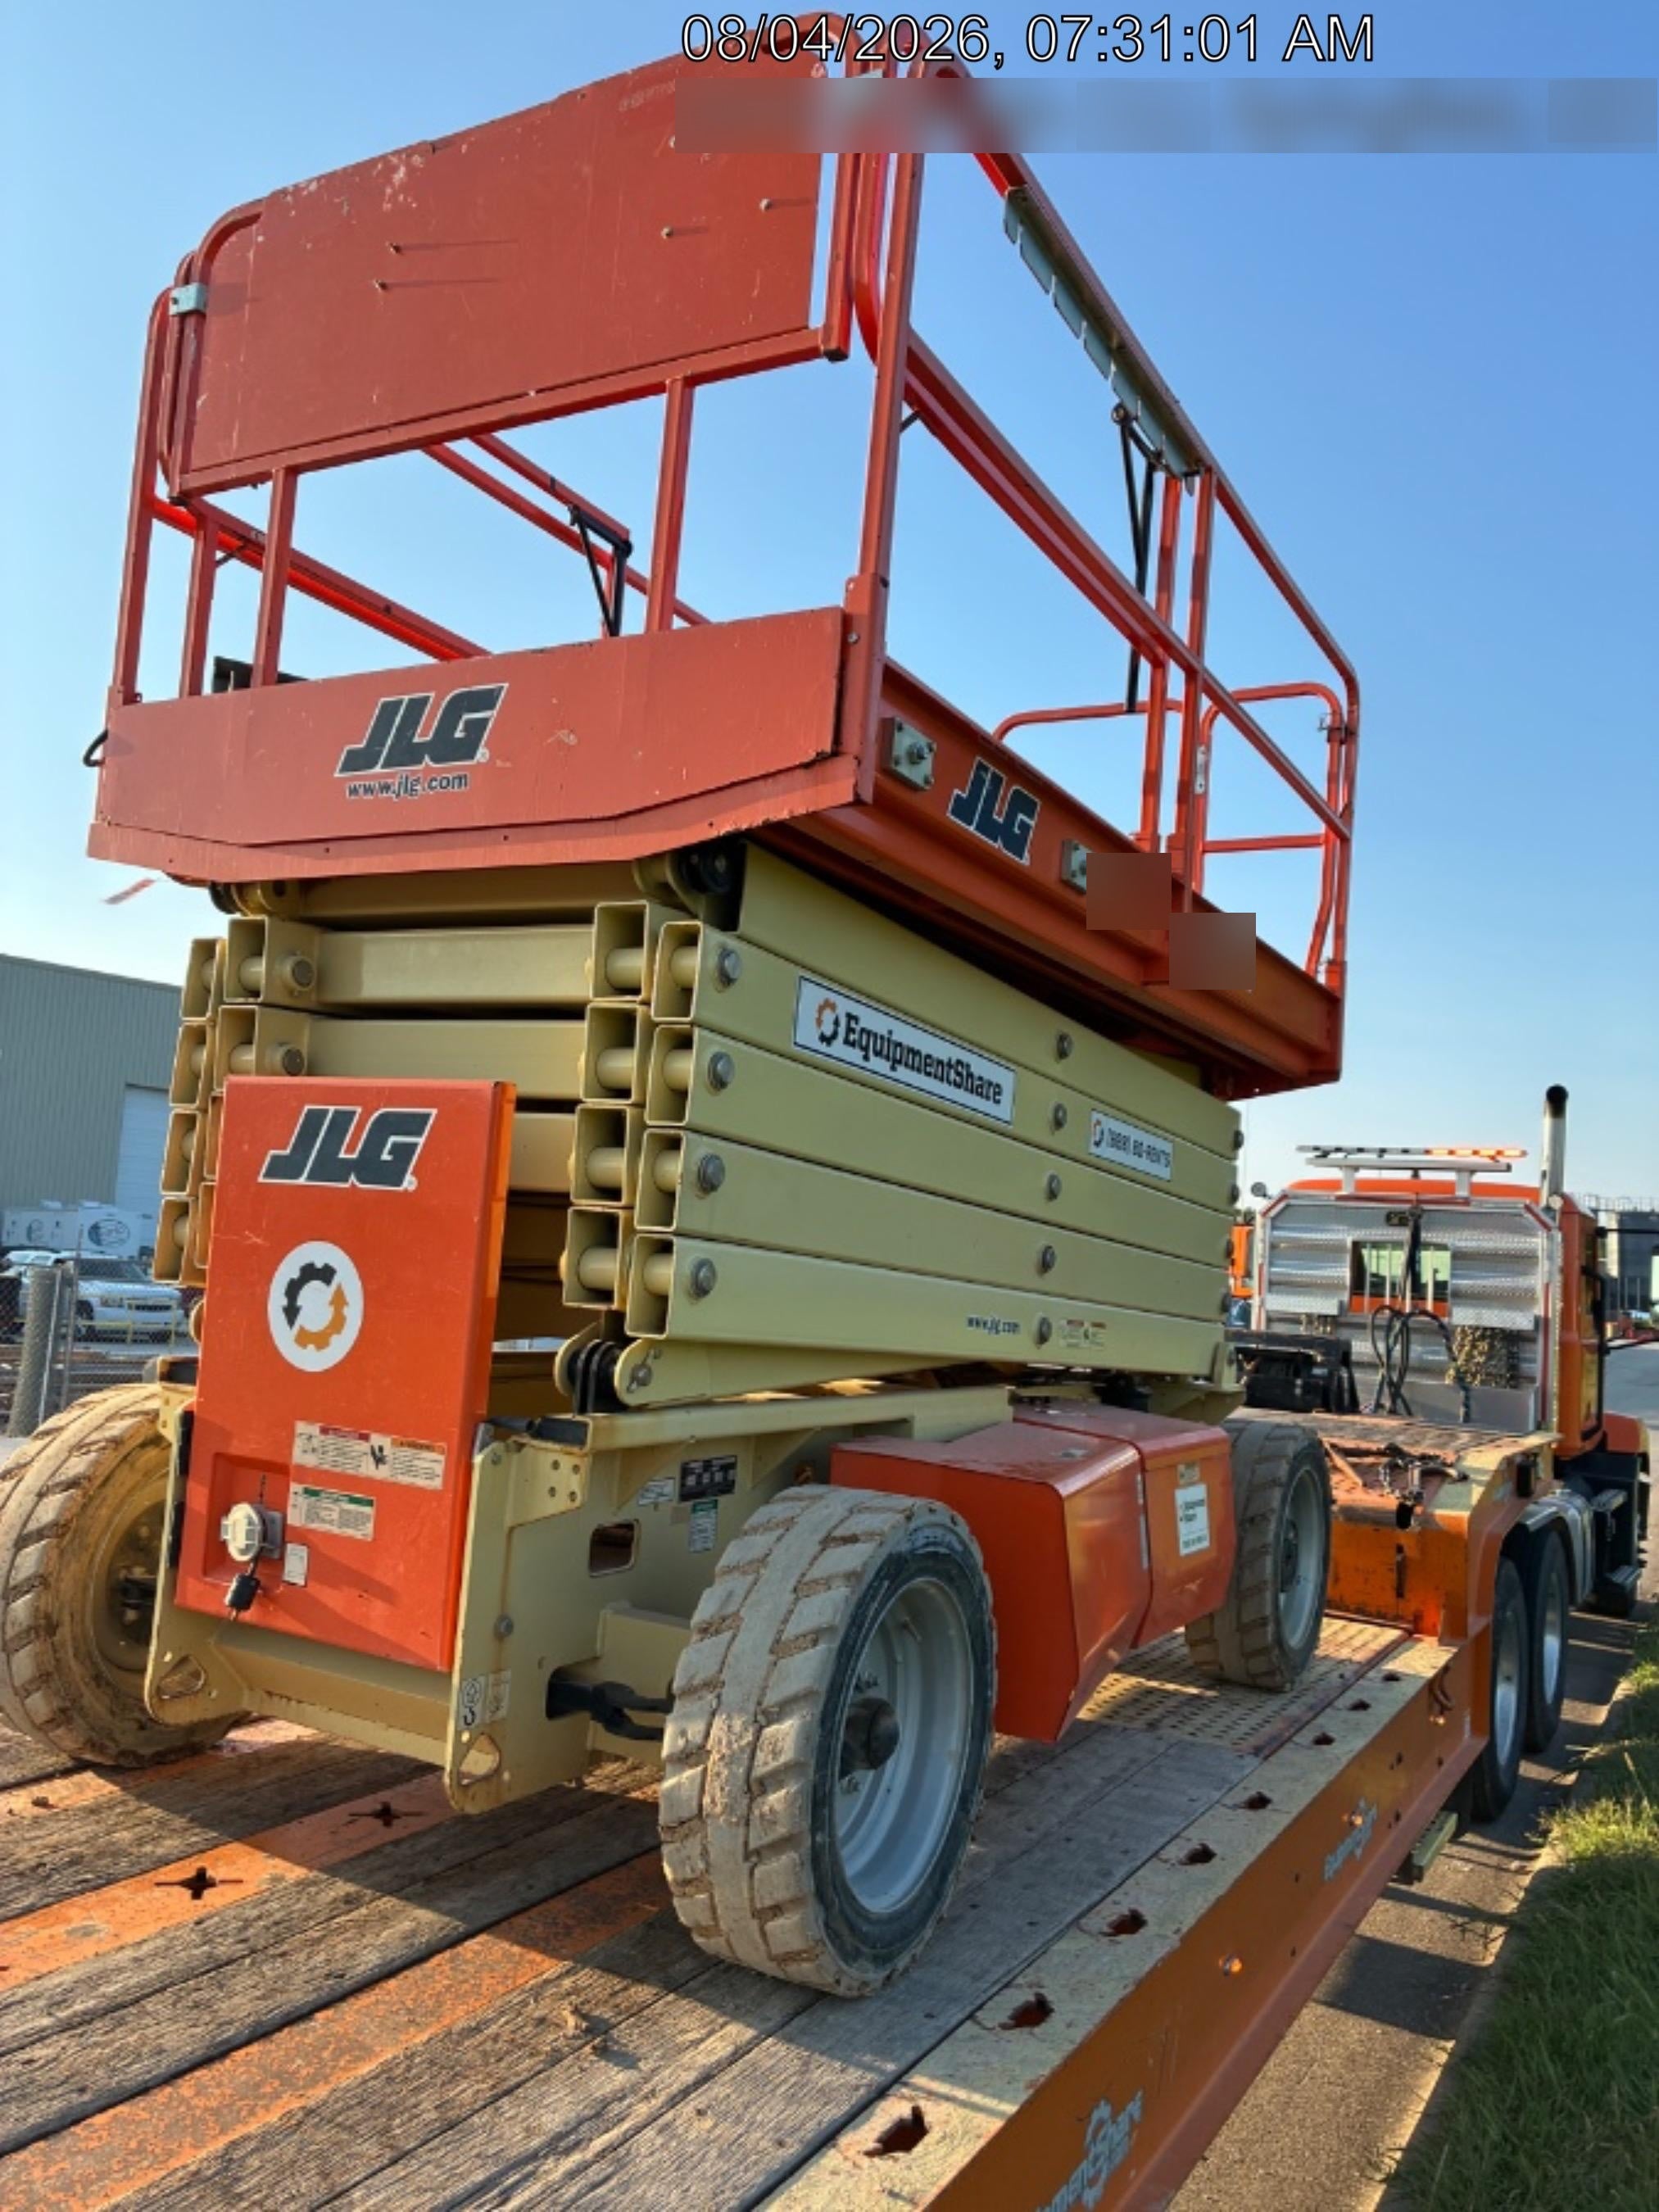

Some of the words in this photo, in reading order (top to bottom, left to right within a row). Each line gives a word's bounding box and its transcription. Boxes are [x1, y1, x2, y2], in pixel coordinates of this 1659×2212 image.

[334, 682, 509, 777] JLG
[347, 773, 469, 801] www.jlg.com
[946, 756, 1041, 865] JLG
[842, 1012, 1004, 1104] EquipmentShare
[257, 1105, 438, 1190] JLG
